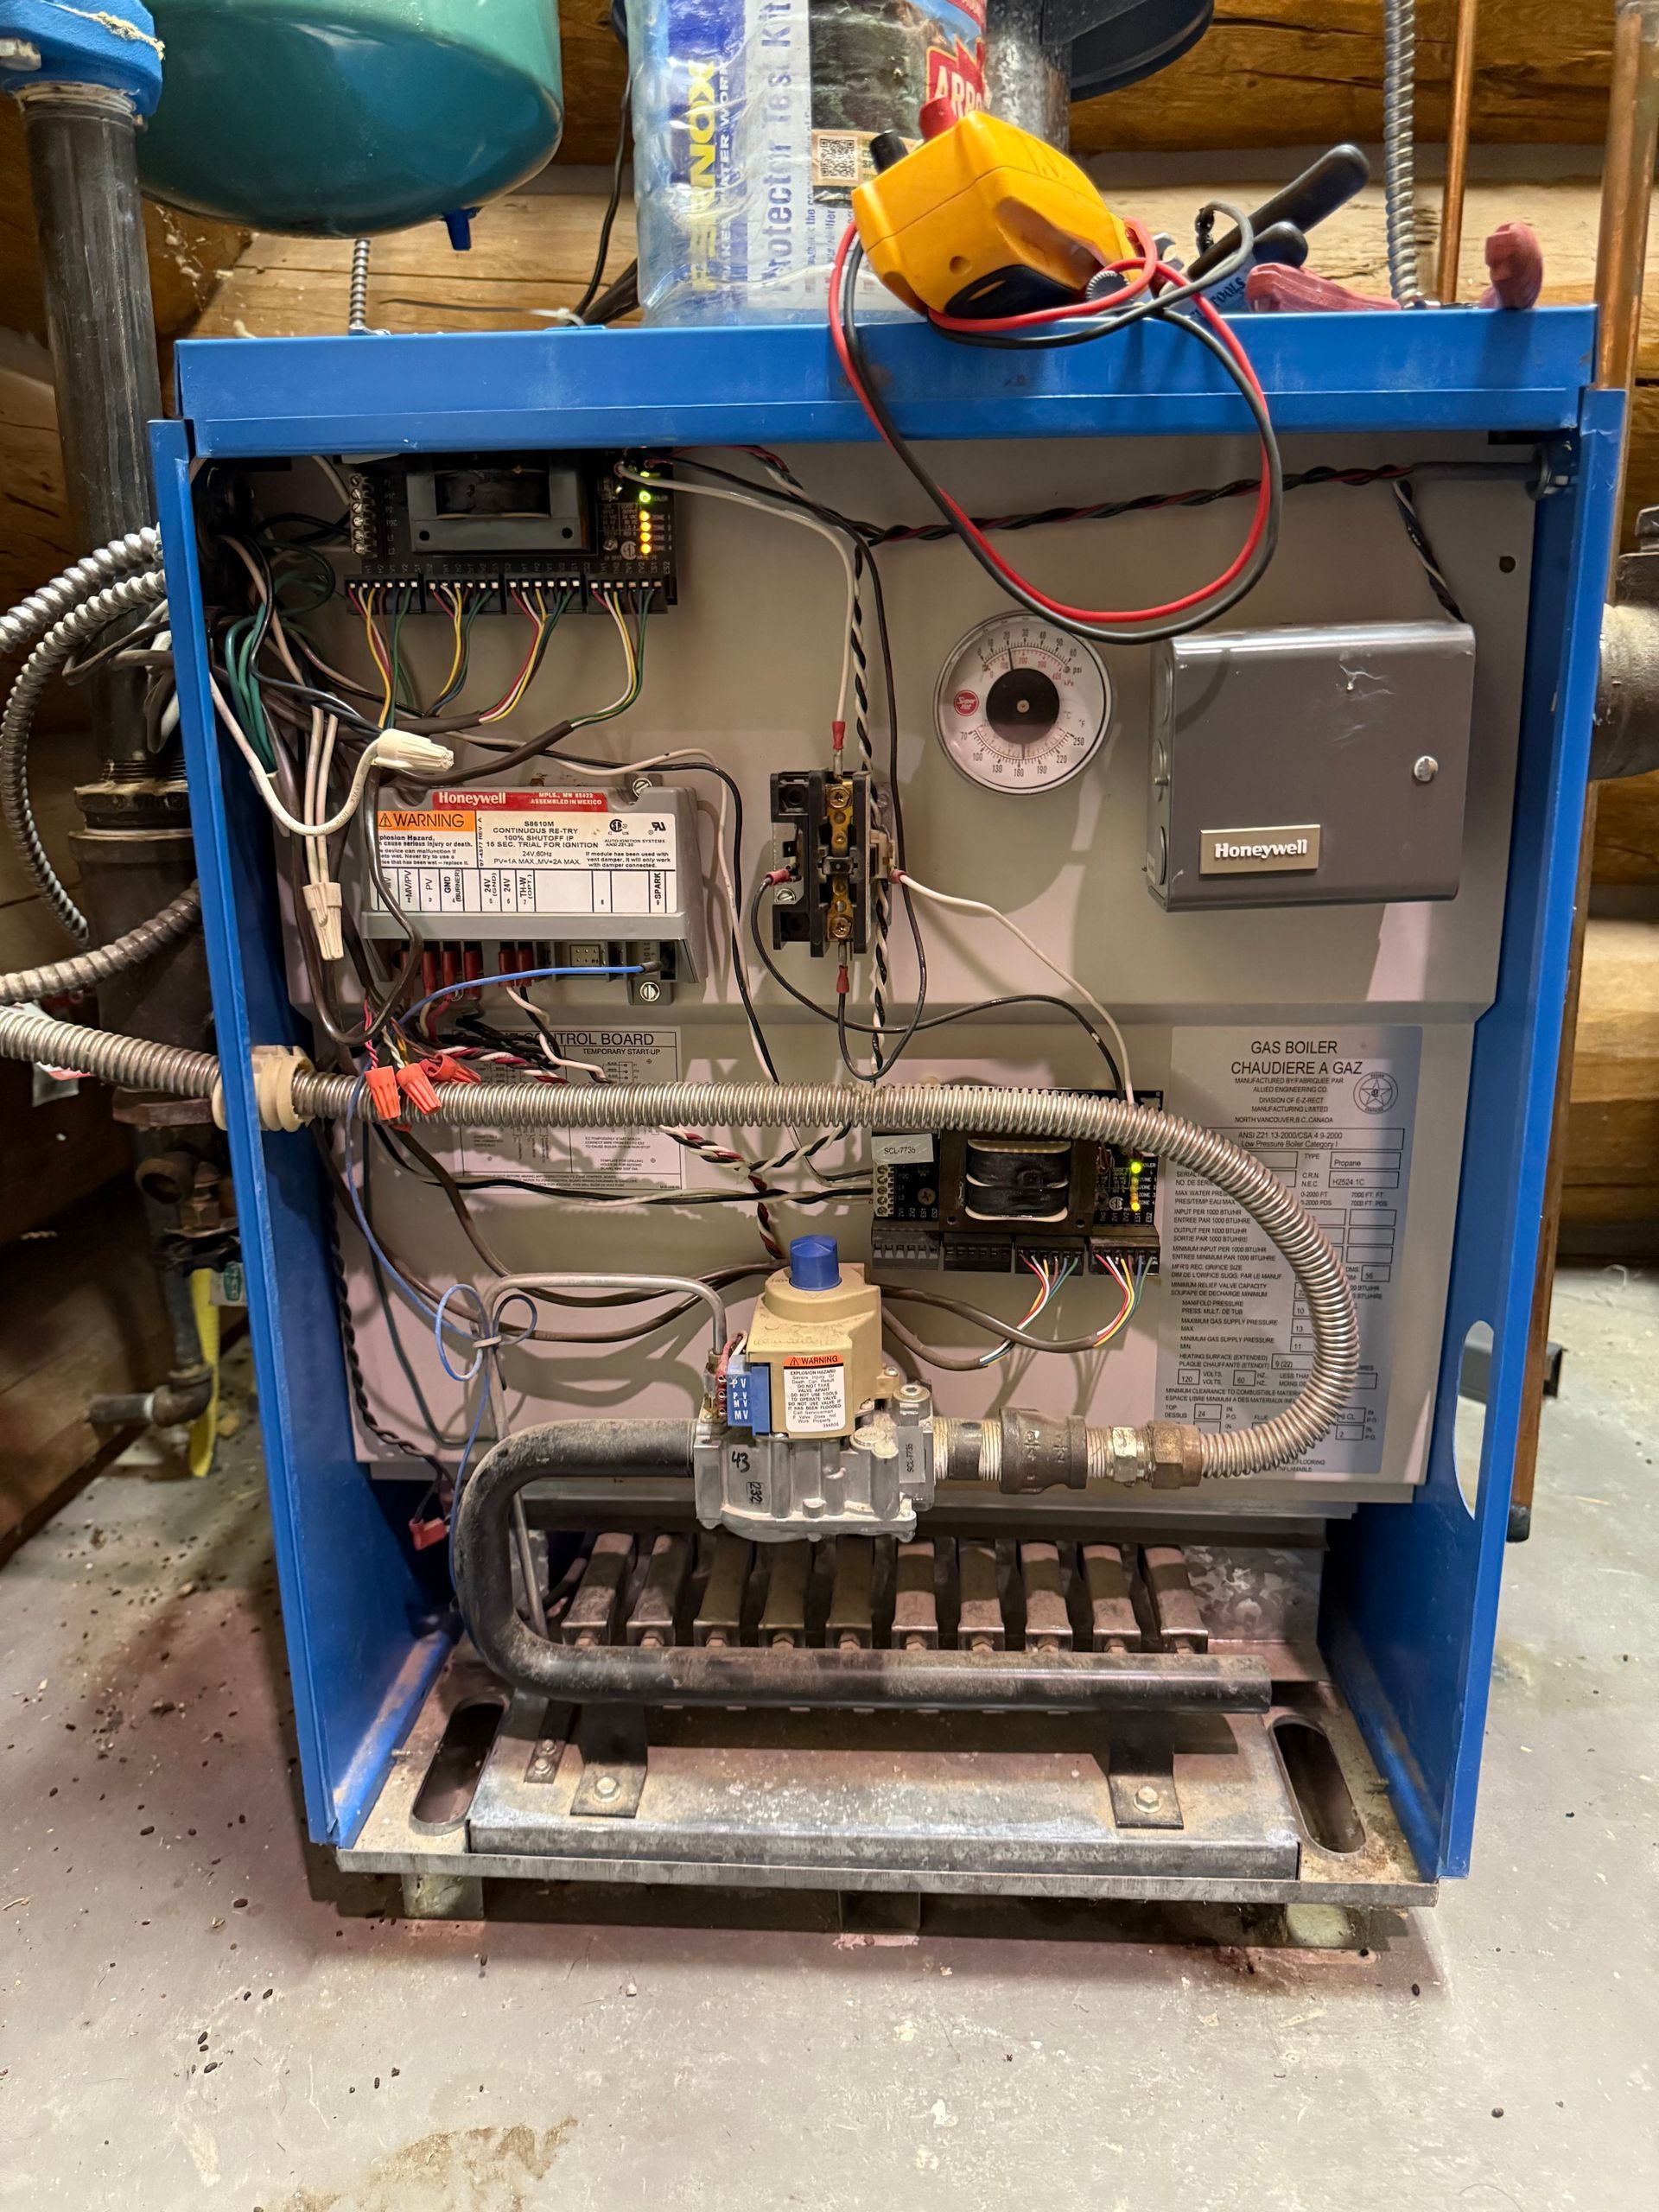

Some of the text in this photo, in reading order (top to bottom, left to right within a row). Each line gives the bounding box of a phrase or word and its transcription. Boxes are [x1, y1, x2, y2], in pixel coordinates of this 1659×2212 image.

[1072, 666, 1083, 675] psi
[960, 731, 968, 741] 70
[1073, 736, 1084, 747] 250
[972, 753, 982, 762] 100
[1056, 753, 1067, 765] 220
[992, 764, 1002, 773] 130
[1037, 765, 1047, 775] 190
[439, 791, 506, 806] Honeywell
[392, 813, 465, 828] WARNING
[1215, 838, 1308, 860] Honeywell
[426, 878, 433, 890] PV
[601, 1033, 654, 1046] BOARD
[1251, 1040, 1338, 1054] GAS BOILER
[1231, 1061, 1363, 1075] CHAUDIERE A GAZ
[1305, 1141, 1334, 1150] Category
[1333, 1159, 1362, 1167] Propane
[802, 1355, 838, 1365] WARNING
[731, 1451, 751, 1473] 43
